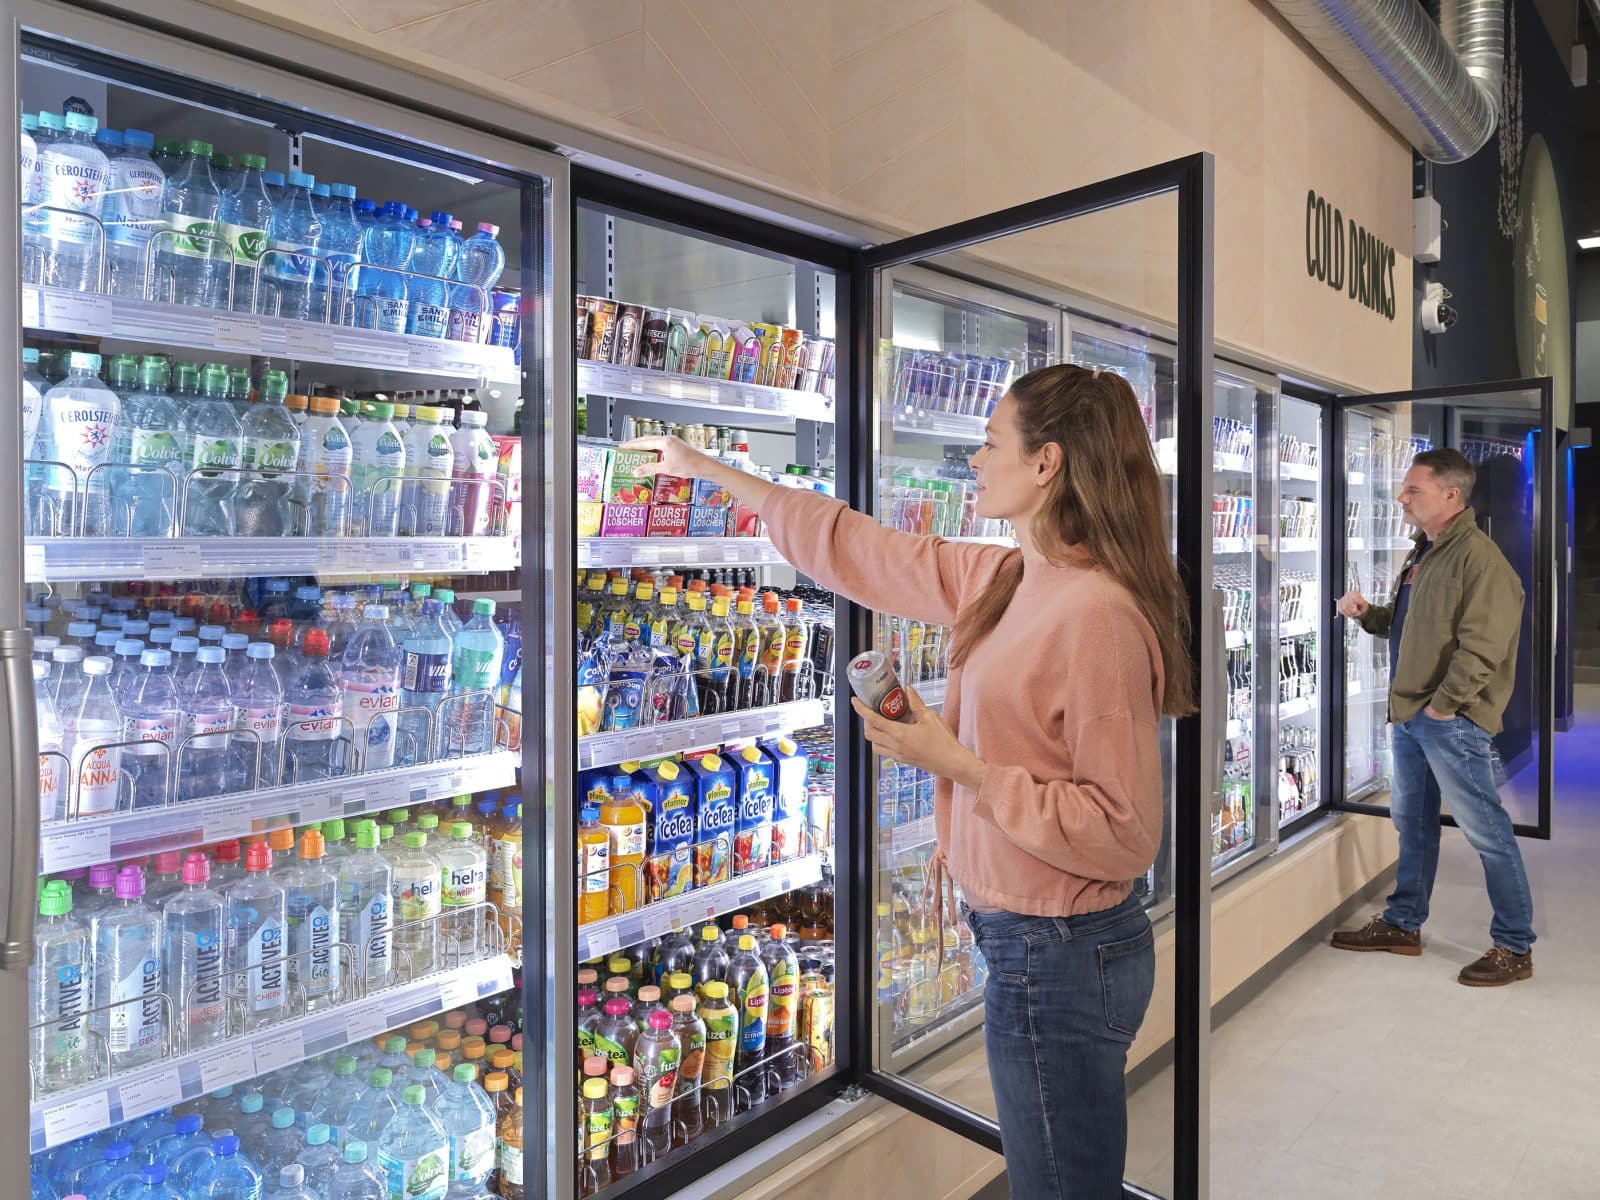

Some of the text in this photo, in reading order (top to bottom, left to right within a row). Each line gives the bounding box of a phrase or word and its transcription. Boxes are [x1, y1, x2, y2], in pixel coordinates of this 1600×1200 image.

[244, 237, 267, 252] Vio
[1306, 189, 1396, 321] COLD DRINKS
[140, 446, 182, 461] Volvic
[616, 453, 655, 466] DURST
[608, 506, 645, 518] DURST
[653, 507, 689, 519] DURST
[694, 507, 725, 519] DURST
[360, 694, 398, 709] evian
[142, 729, 174, 742] evian
[86, 759, 112, 771] ACQUA
[451, 871, 484, 886] hela
[411, 881, 436, 897] hel
[312, 925, 330, 965] ACTIVE
[262, 940, 282, 990] ACTIVE
[196, 943, 220, 1005] ACTIVE
[58, 974, 82, 1032] ACTIVE
[142, 970, 161, 1026] ACTVE
[750, 997, 766, 1006] Lipt
